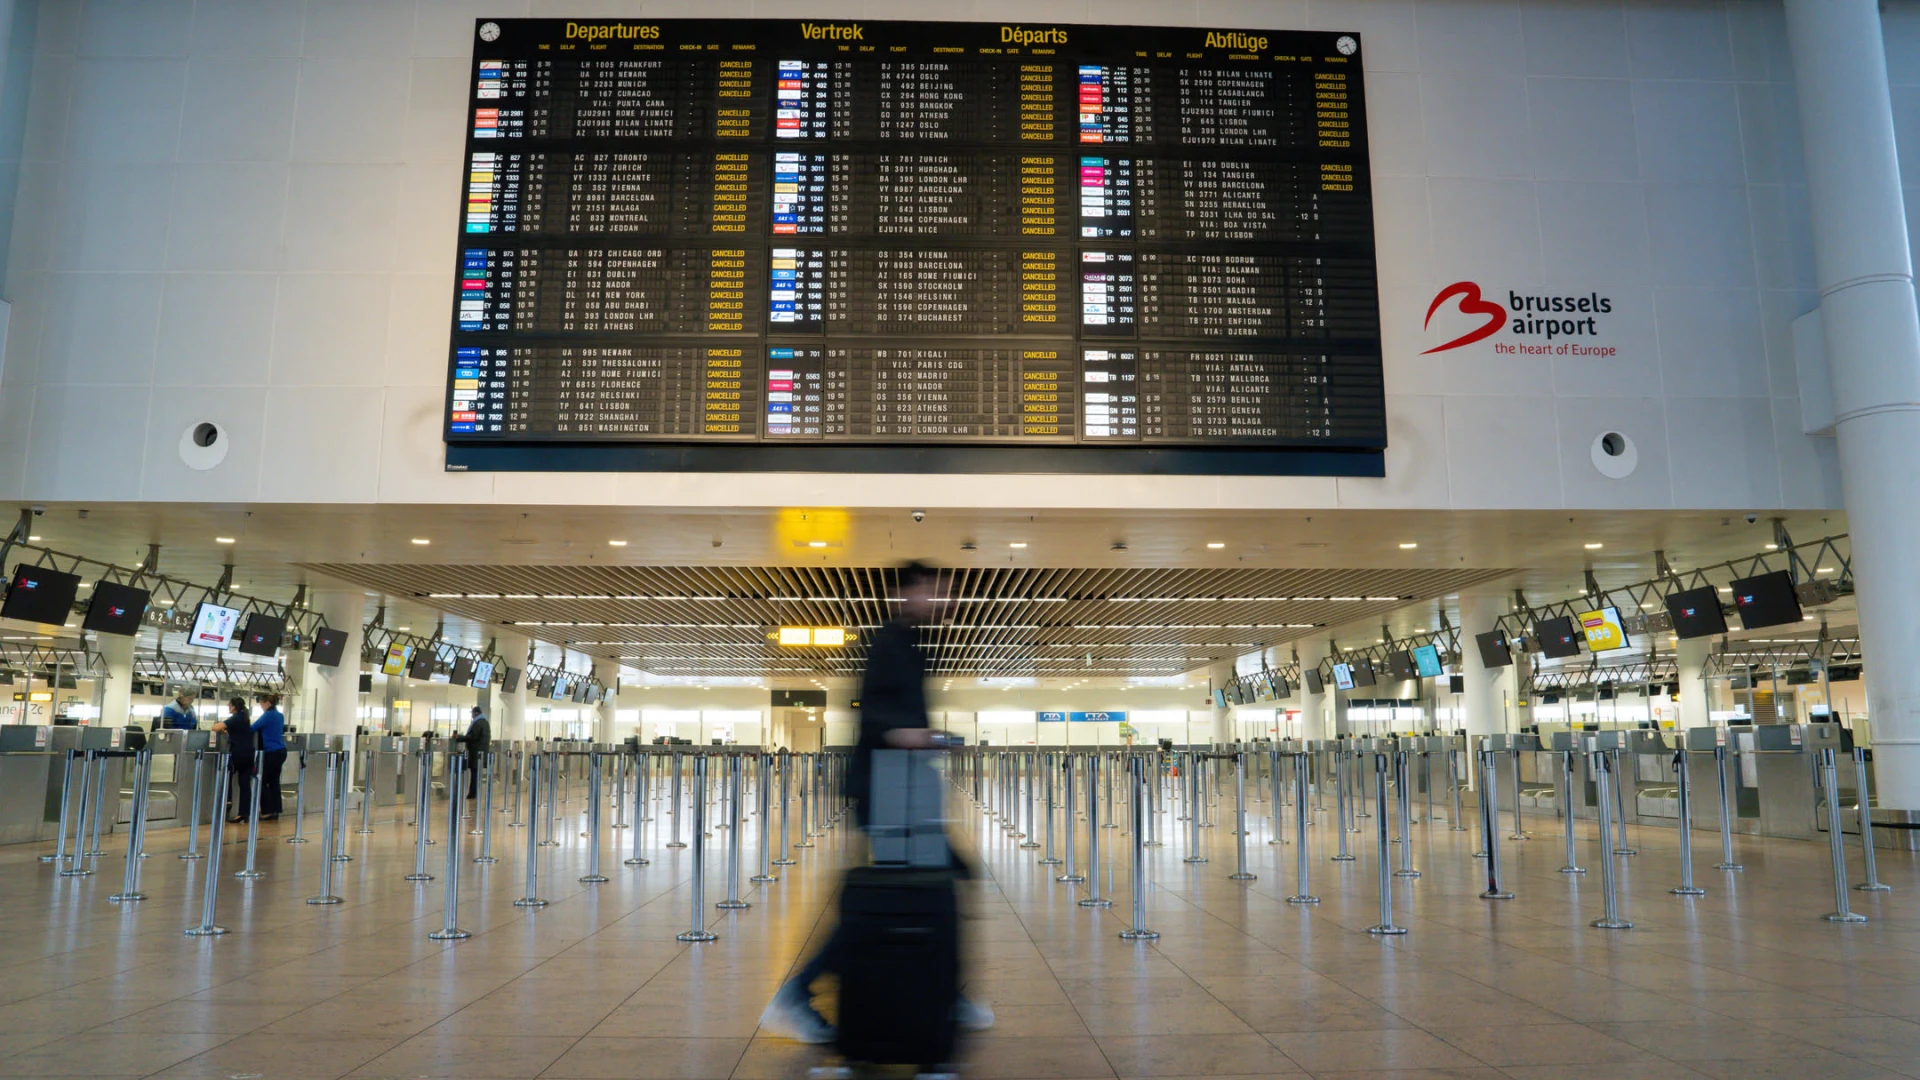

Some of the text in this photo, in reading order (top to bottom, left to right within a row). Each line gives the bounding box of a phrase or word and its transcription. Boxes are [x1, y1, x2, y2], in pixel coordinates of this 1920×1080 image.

[566, 22, 660, 42] Departures
[801, 23, 863, 40] Vertrek
[1001, 26, 1067, 46] Départs
[1205, 32, 1268, 52] Abflüge
[1218, 89, 1264, 97] CASABLANCA
[1219, 118, 1247, 126] LISBON
[1318, 130, 1349, 138] CANCELLED
[1223, 201, 1266, 209] HERAKLION
[1224, 231, 1253, 239] LISBON
[918, 251, 1055, 260] VIENNA CANCELLED
[918, 282, 962, 290] STOCKHOLM
[1023, 283, 1056, 291] CANCELLED
[1509, 291, 1612, 313] brussels
[918, 303, 967, 311] COPENHAGEN
[709, 312, 743, 320] CANCELLED
[1513, 314, 1597, 340] airport
[1495, 343, 1616, 358] the heart of Europe
[1023, 351, 1057, 359] CANCELLED
[602, 359, 661, 367] THESSALONIKI
[1024, 393, 1057, 401] CANCELLED
[600, 402, 630, 410] LISBON
[917, 404, 947, 412] ATHENS
[917, 415, 948, 423] ZURICH
[150, 613, 163, 622] 6.2
[176, 617, 187, 627] 6.3
